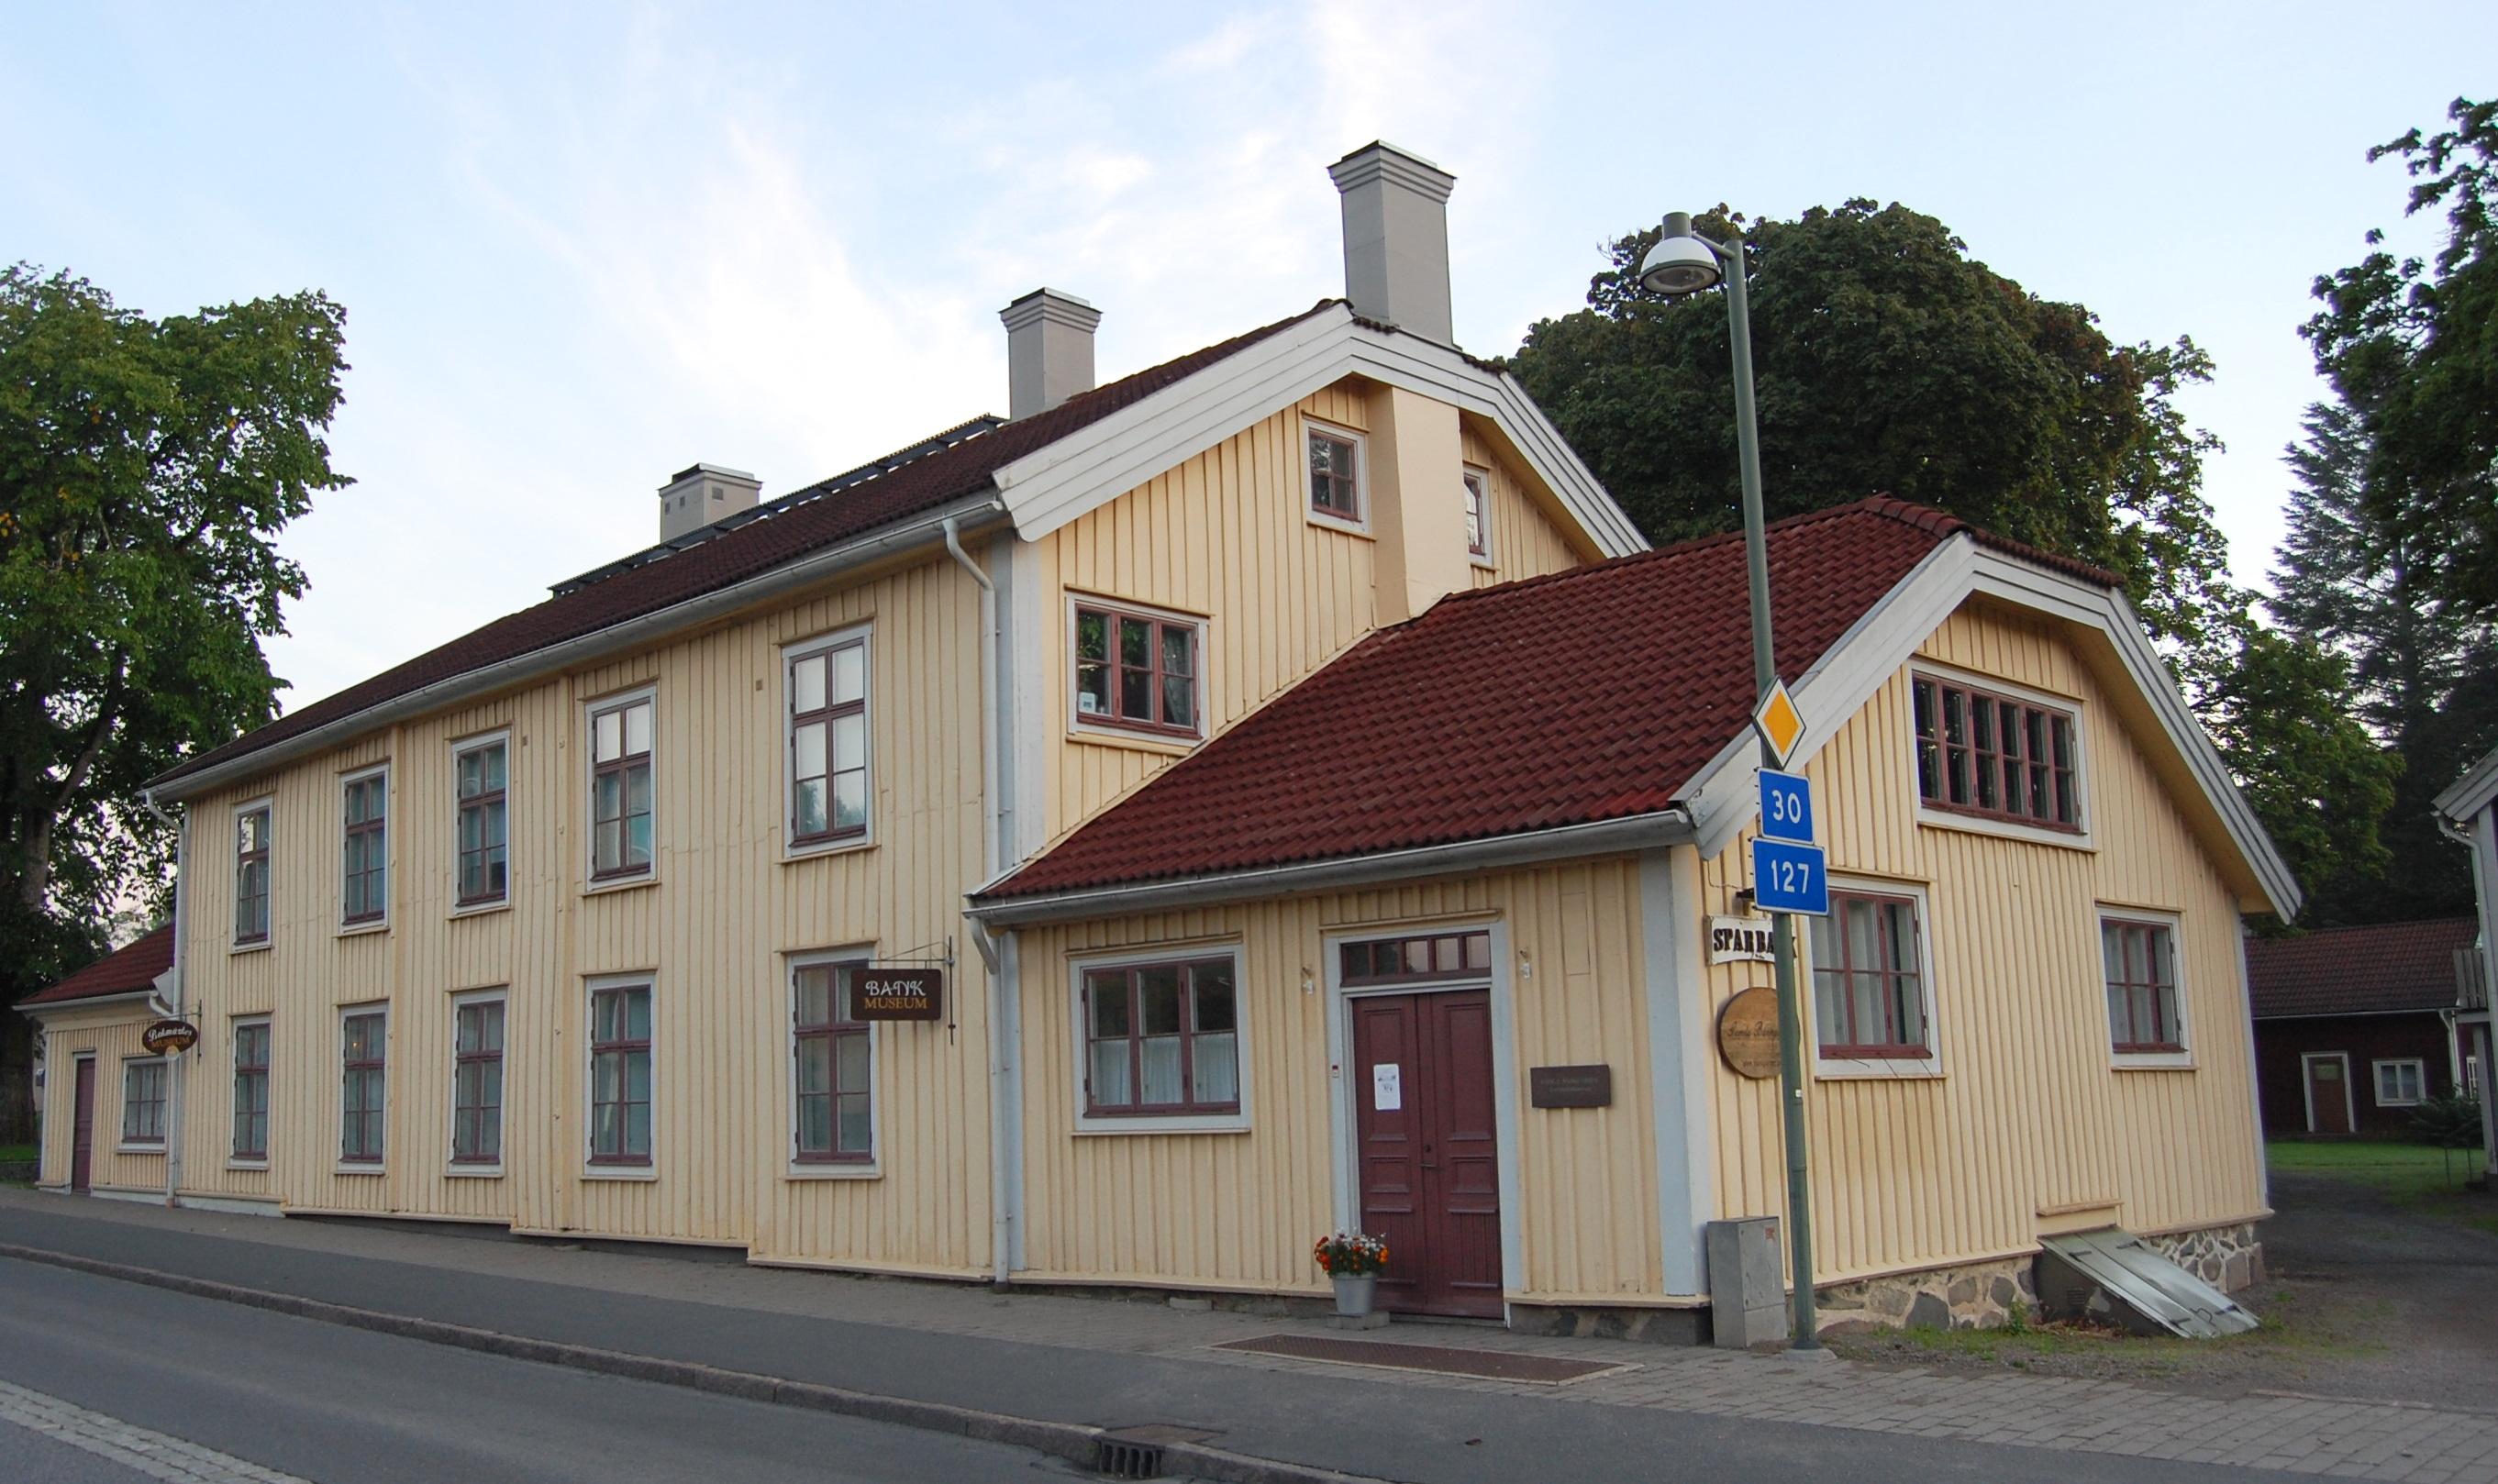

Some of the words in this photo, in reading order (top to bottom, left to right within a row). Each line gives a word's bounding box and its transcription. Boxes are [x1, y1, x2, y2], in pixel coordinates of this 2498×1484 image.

[1771, 790, 1802, 824] 30
[1771, 859, 1809, 893] 127
[1713, 927, 1798, 958] SPARBA
[865, 997, 927, 1009] MUSEUM
